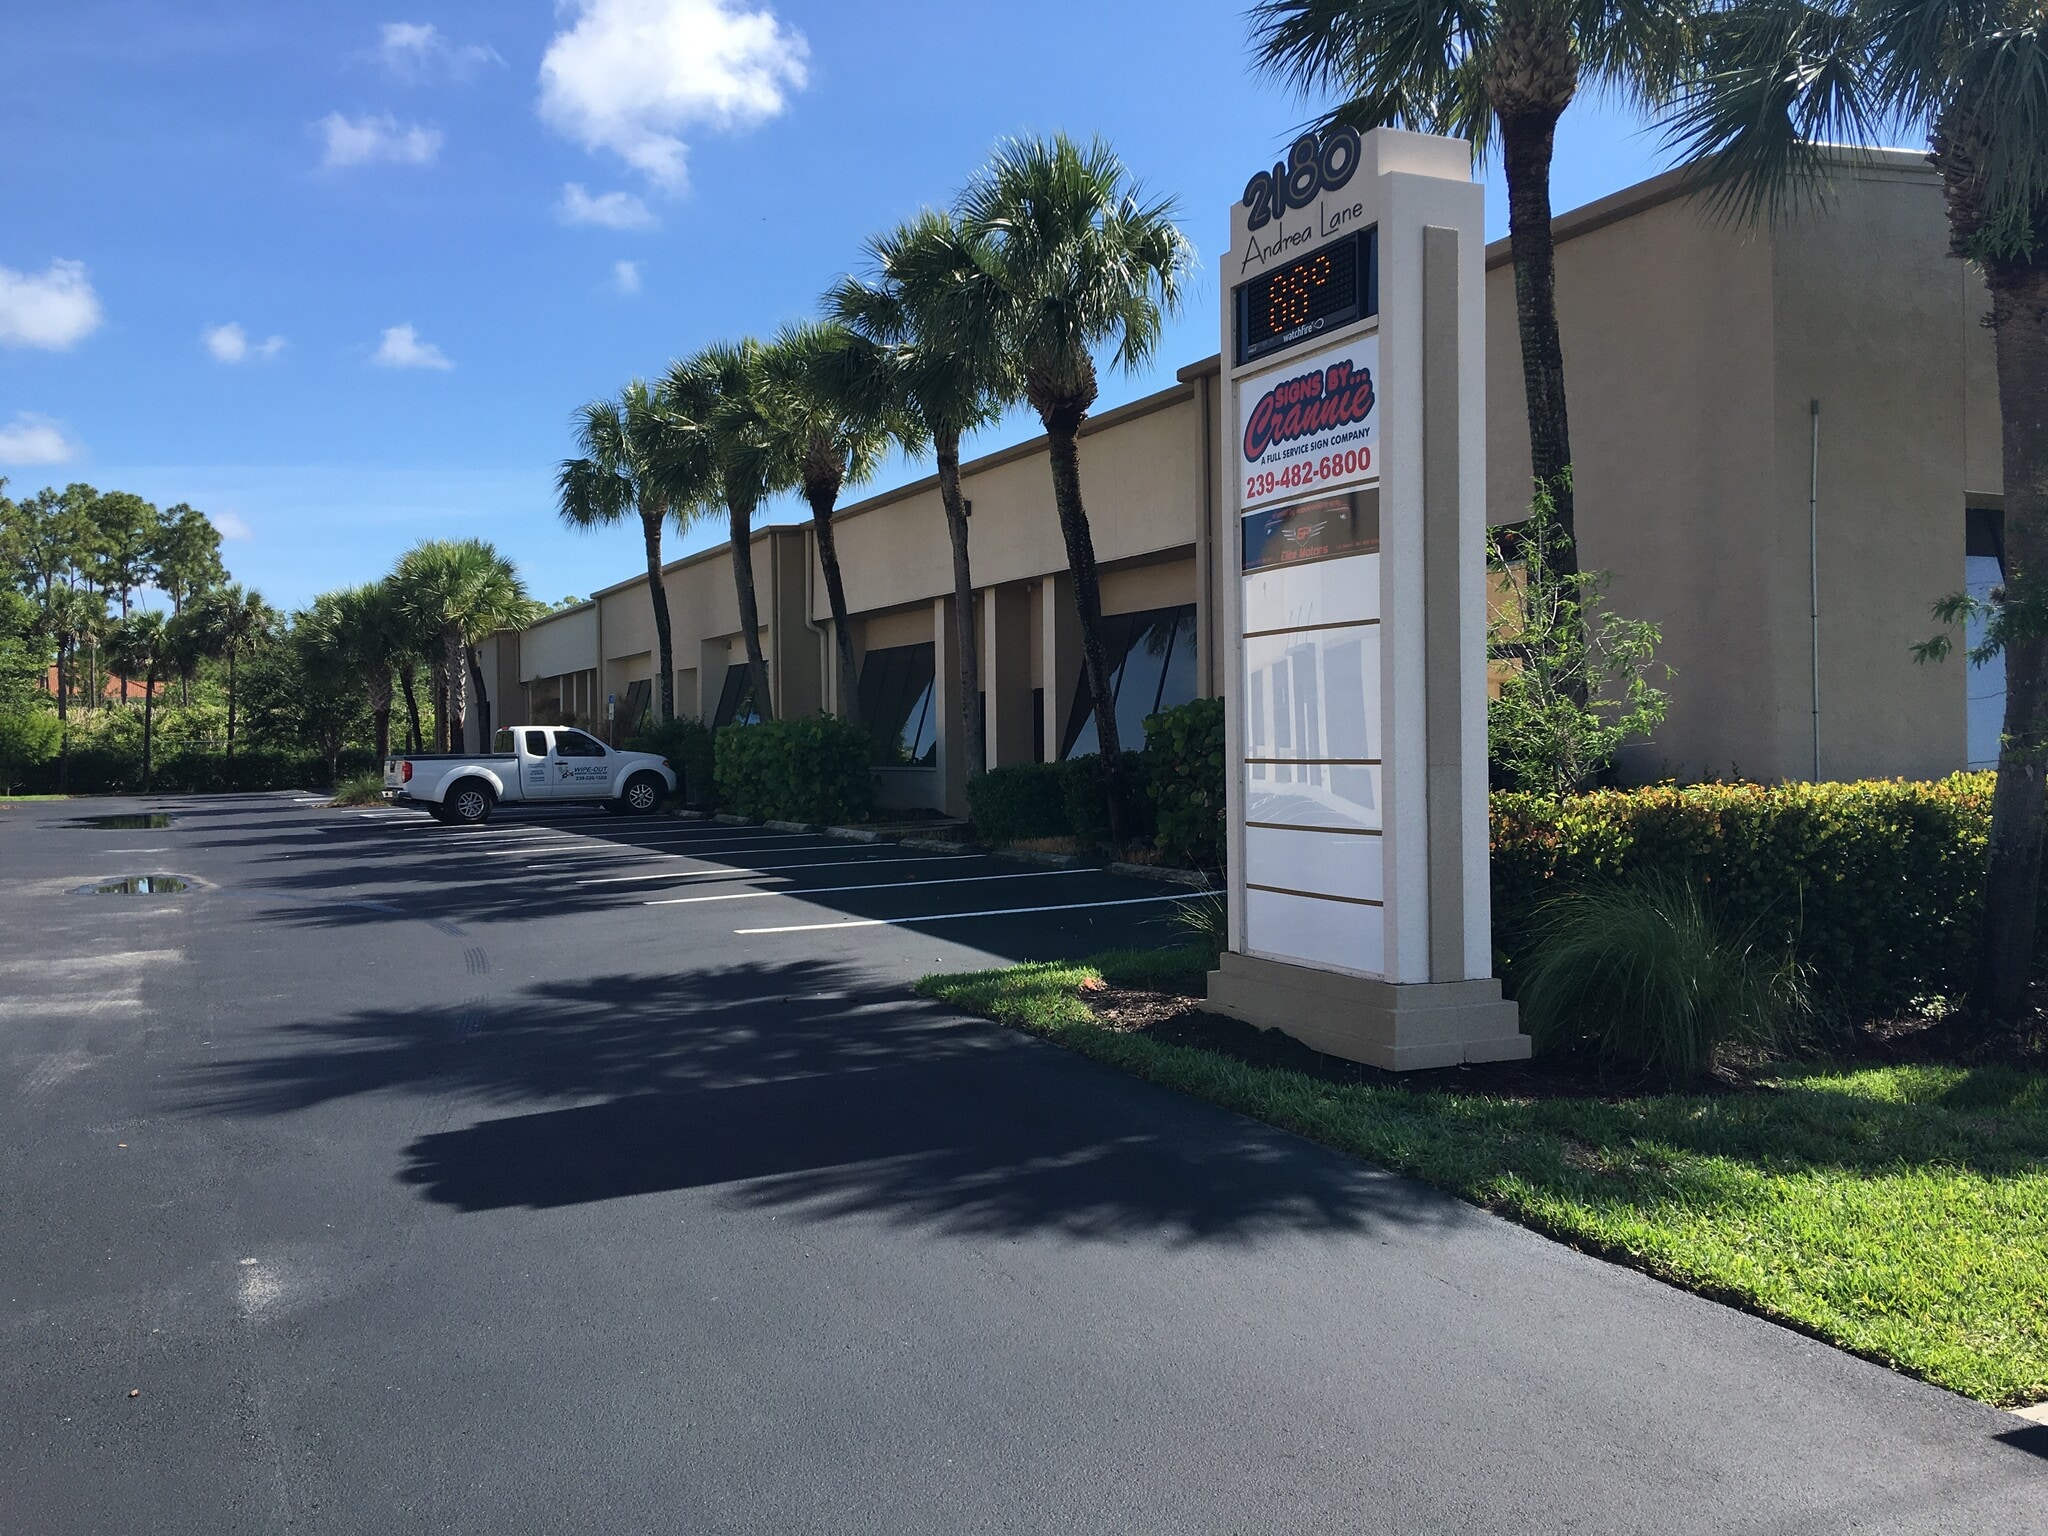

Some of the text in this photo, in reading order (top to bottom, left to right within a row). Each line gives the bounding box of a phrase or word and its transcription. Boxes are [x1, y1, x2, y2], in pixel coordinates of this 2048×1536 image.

[1243, 126, 1361, 231] 2180
[1241, 201, 1363, 274] Andrea Lane
[1273, 370, 1323, 408] SIGNS
[1244, 381, 1375, 462] Crannie
[1260, 427, 1371, 466] A FULL SERVICE SIGN COMPANY
[1246, 446, 1372, 499] 239-482-6800
[1298, 545, 1329, 558] Motors
